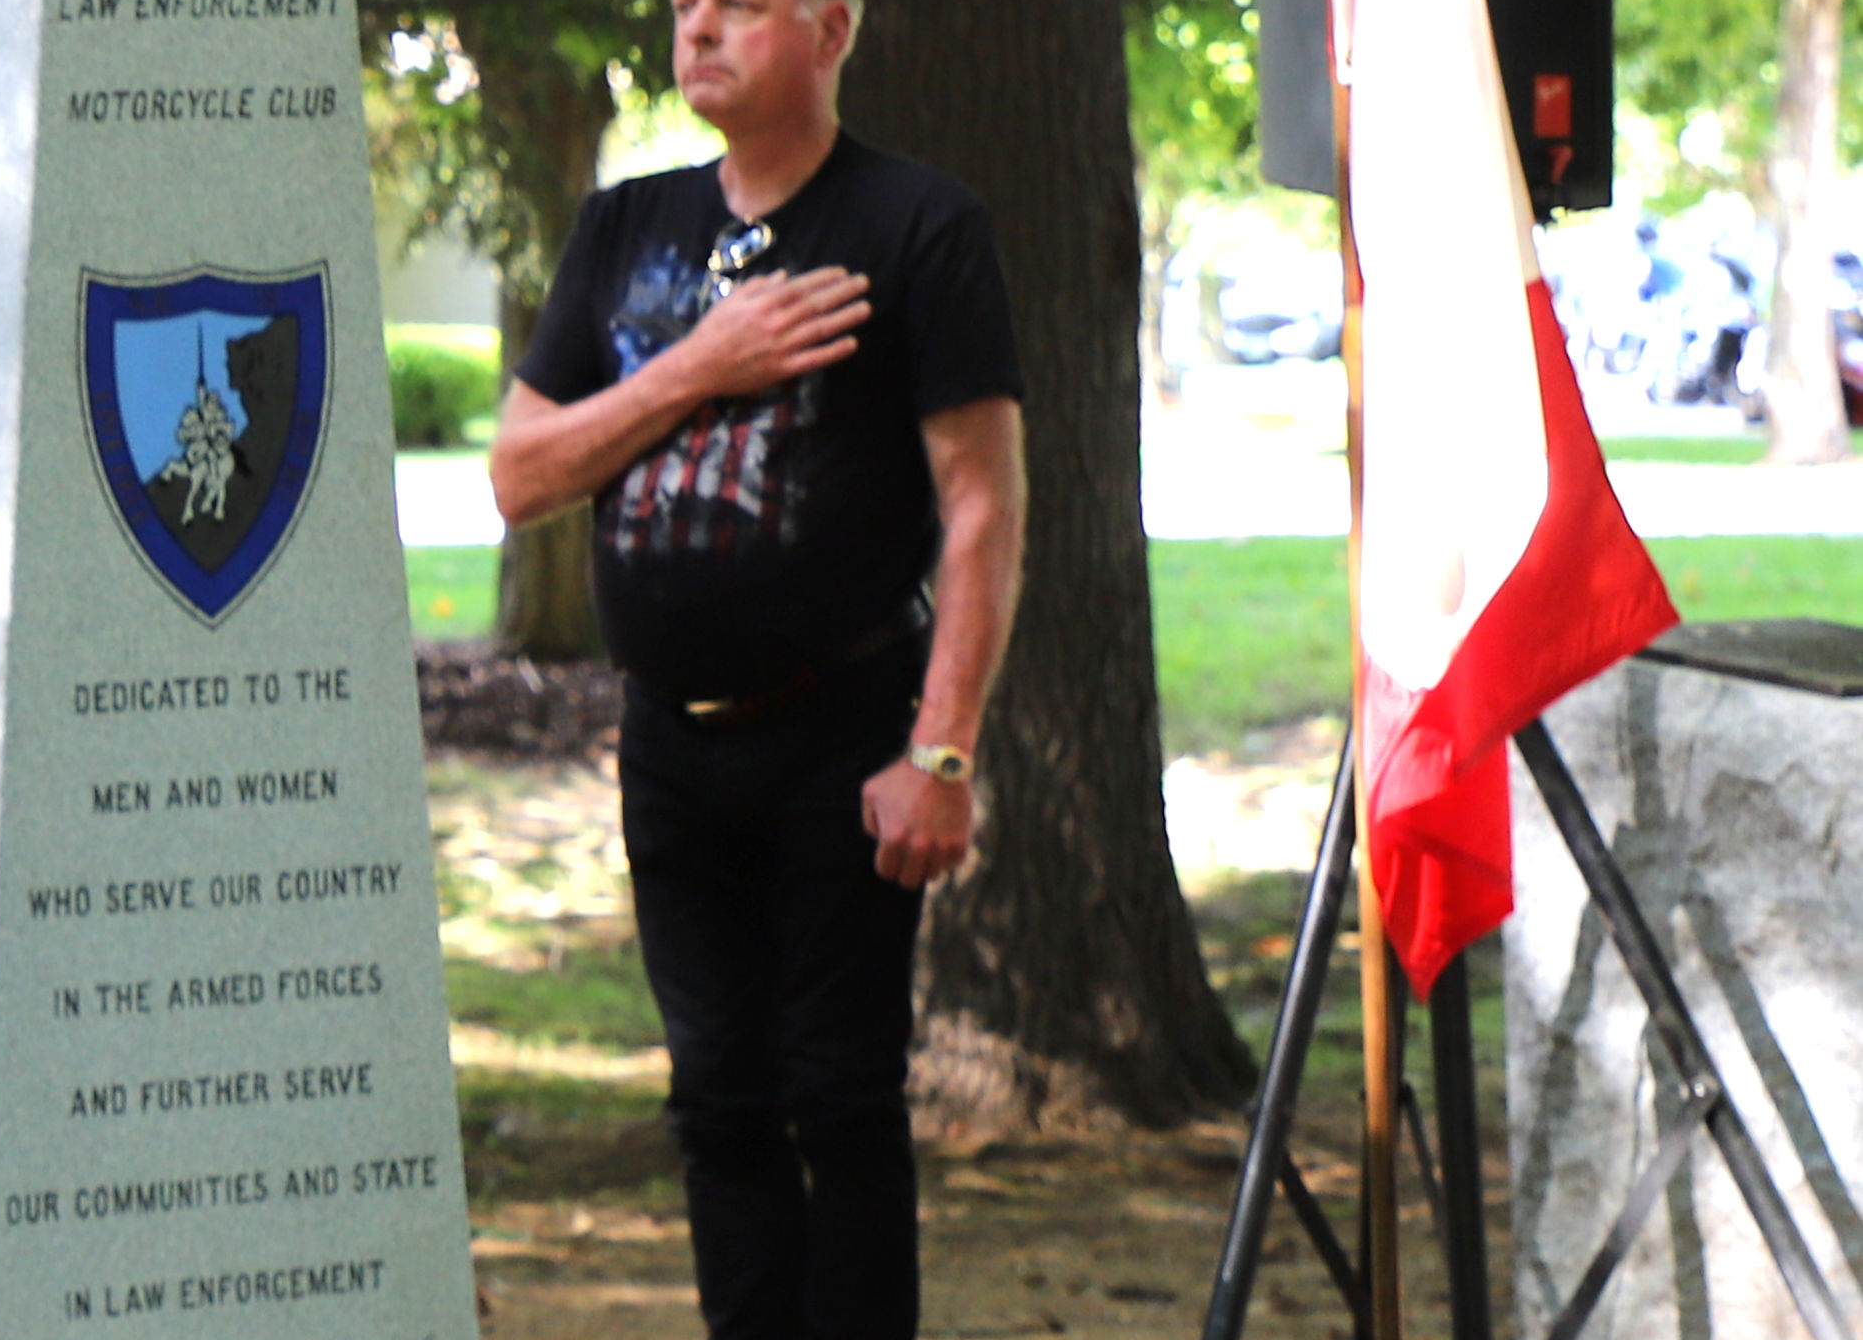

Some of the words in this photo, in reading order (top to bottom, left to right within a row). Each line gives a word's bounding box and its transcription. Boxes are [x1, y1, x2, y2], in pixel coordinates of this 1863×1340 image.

[69, 87, 255, 122] MOTORCYCLE
[269, 86, 338, 117] CLUB
[74, 675, 229, 715] DEDICATED
[245, 672, 280, 705] TO
[296, 668, 352, 702] THE
[92, 781, 151, 814] MEN
[167, 775, 222, 809] AND
[237, 769, 338, 806] WOMEN
[28, 885, 91, 921] WHO
[106, 878, 195, 914] SERVE
[211, 874, 262, 908] OUR
[278, 863, 402, 902] COUNTRY
[53, 989, 80, 1019] IN
[97, 980, 152, 1015] THE
[168, 972, 265, 1010] ARMED
[278, 964, 383, 1002] FORCES
[72, 1084, 127, 1118] AND
[141, 1072, 270, 1112] FURTHER
[285, 1063, 374, 1100] SERVE
[6, 1193, 59, 1226] OUR
[75, 1172, 269, 1220] COMMUNITIES
[284, 1165, 338, 1200] AND
[353, 1156, 438, 1194] STATE
[66, 1289, 91, 1322] IN
[106, 1280, 165, 1317] LAW
[181, 1260, 385, 1311] ENFORCEMENT
